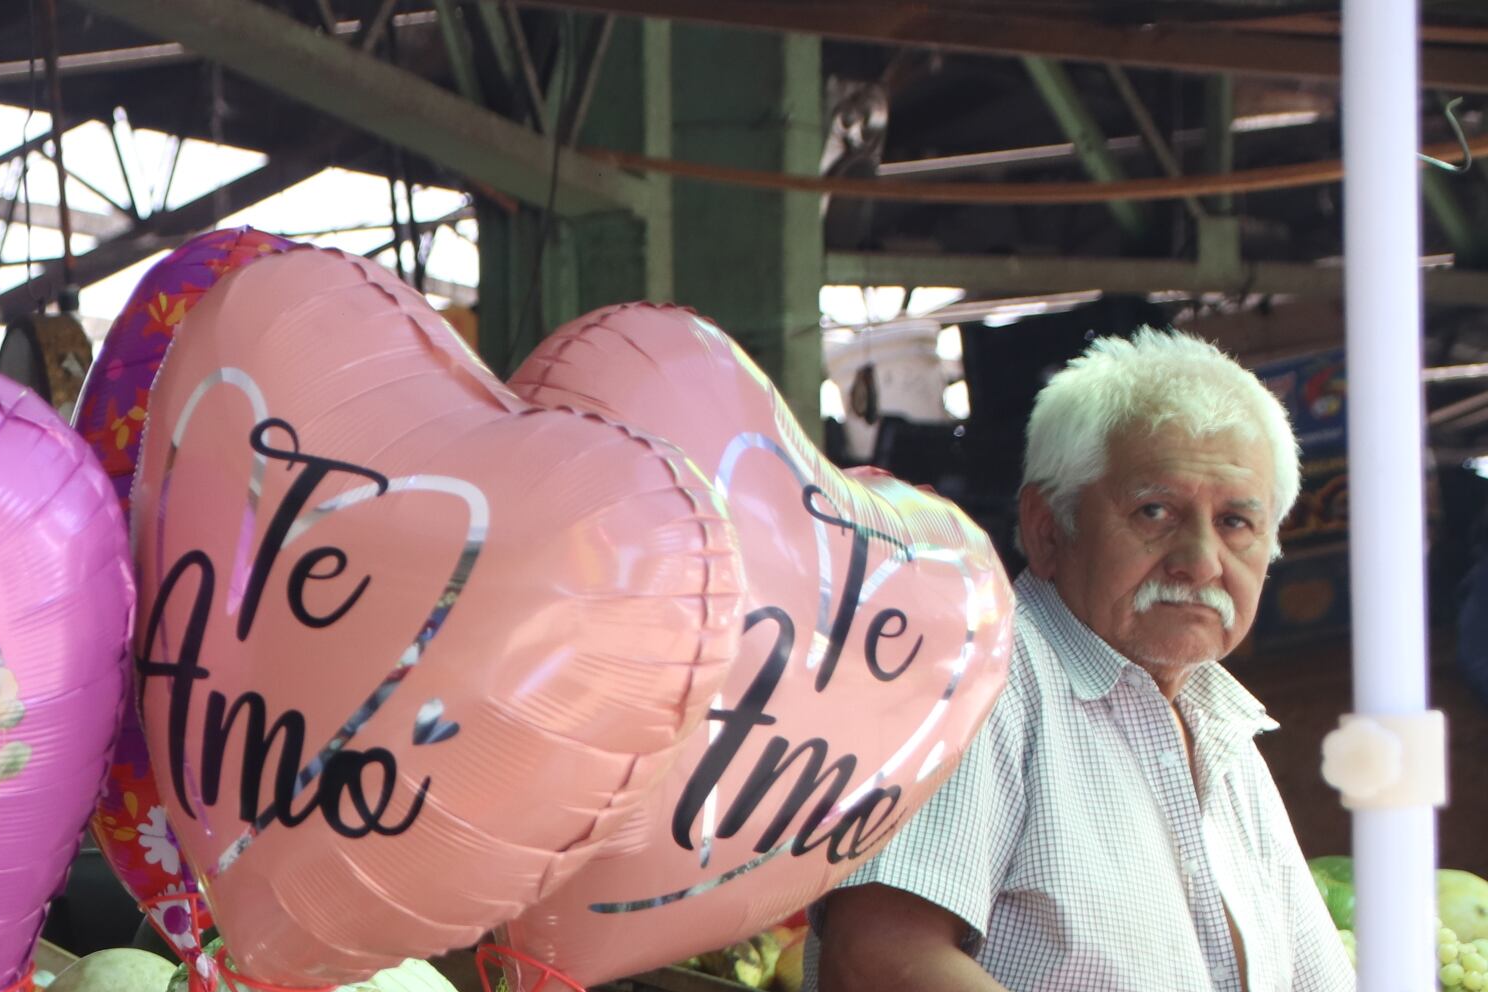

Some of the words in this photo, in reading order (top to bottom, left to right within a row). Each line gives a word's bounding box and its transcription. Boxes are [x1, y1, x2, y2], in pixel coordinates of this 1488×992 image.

[236, 417, 389, 642] Te
[802, 484, 924, 693] Te
[135, 549, 432, 839] Amo
